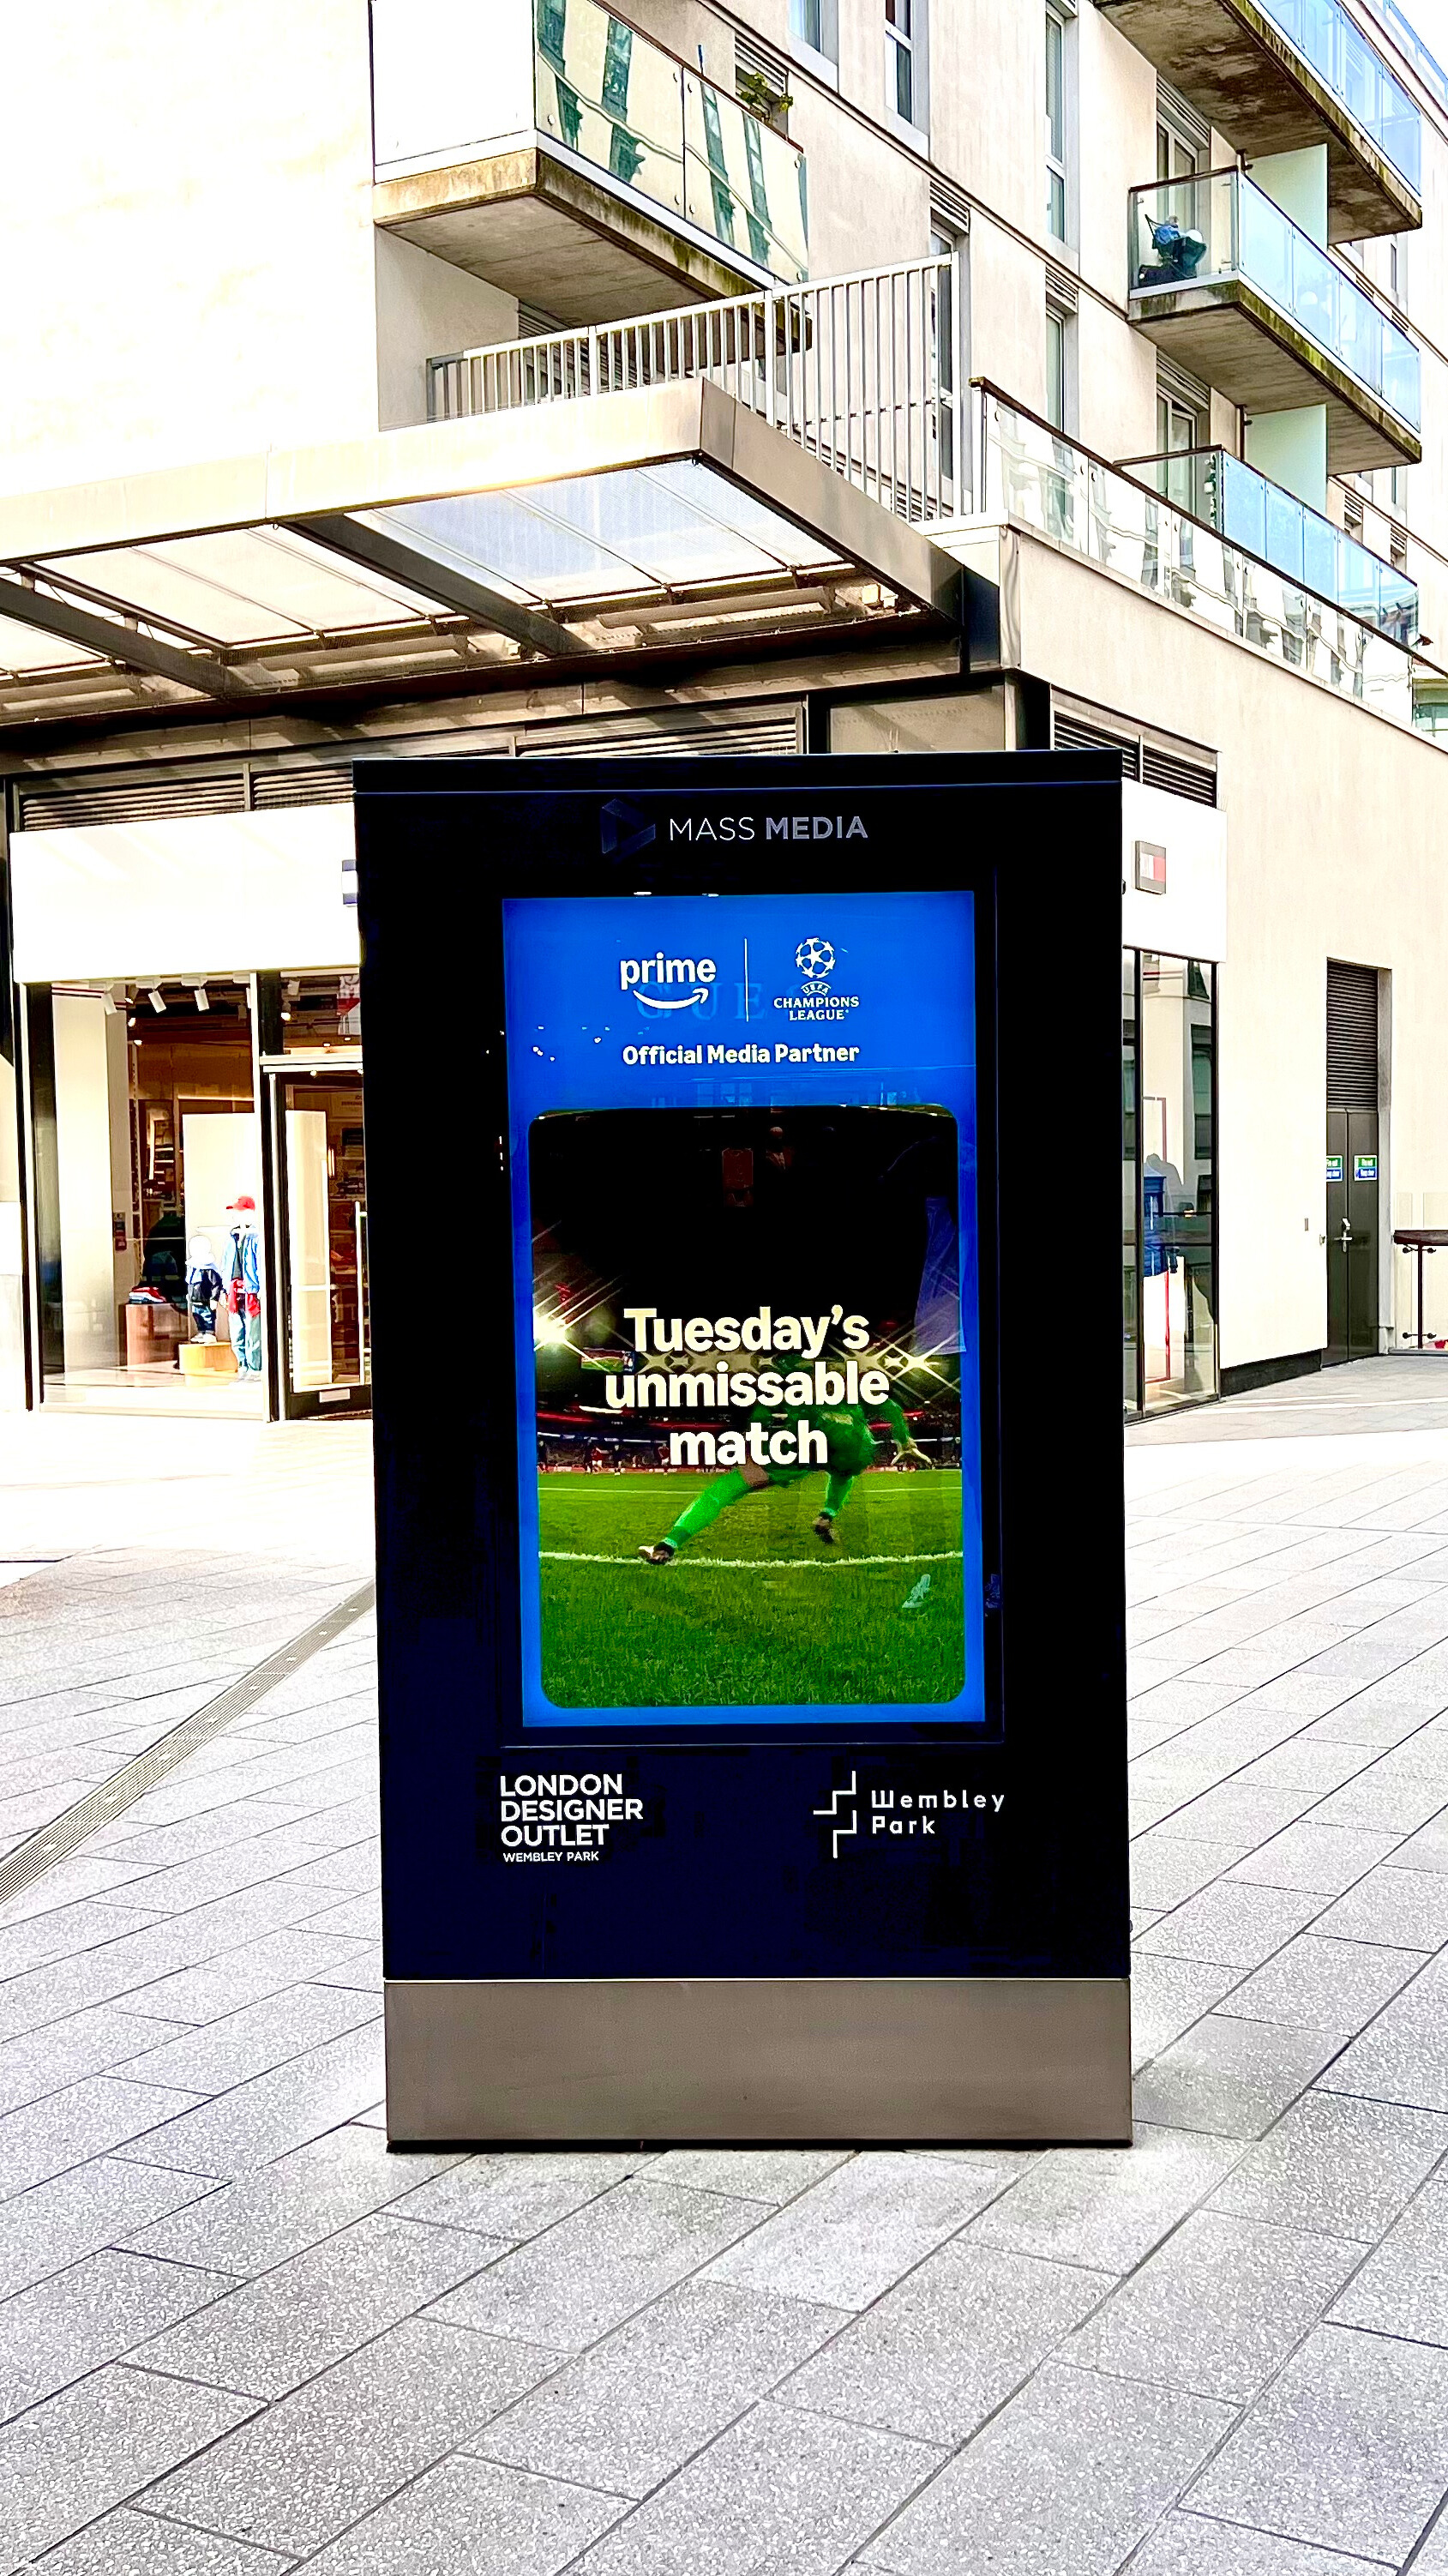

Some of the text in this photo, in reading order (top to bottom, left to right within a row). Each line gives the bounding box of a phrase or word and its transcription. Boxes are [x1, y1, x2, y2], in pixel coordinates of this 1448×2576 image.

[670, 816, 868, 840] MASS MEDIA
[620, 952, 717, 990] prime
[802, 983, 829, 994] UEFA
[773, 996, 860, 1008] CHAMPIONS
[789, 1009, 845, 1020] LEAGUE
[622, 1043, 860, 1065] Official Media Partner
[623, 1304, 869, 1359] Tuesday's
[605, 1360, 890, 1408] unmissable
[669, 1419, 828, 1466] match
[500, 1773, 623, 1797] LONDON
[501, 1798, 644, 1822] DESIGNER
[871, 1790, 1005, 1813] Wembley
[501, 1823, 610, 1847] OUTLET
[872, 1815, 935, 1834] Park
[502, 1851, 599, 1863] WEMBLEY PARK
